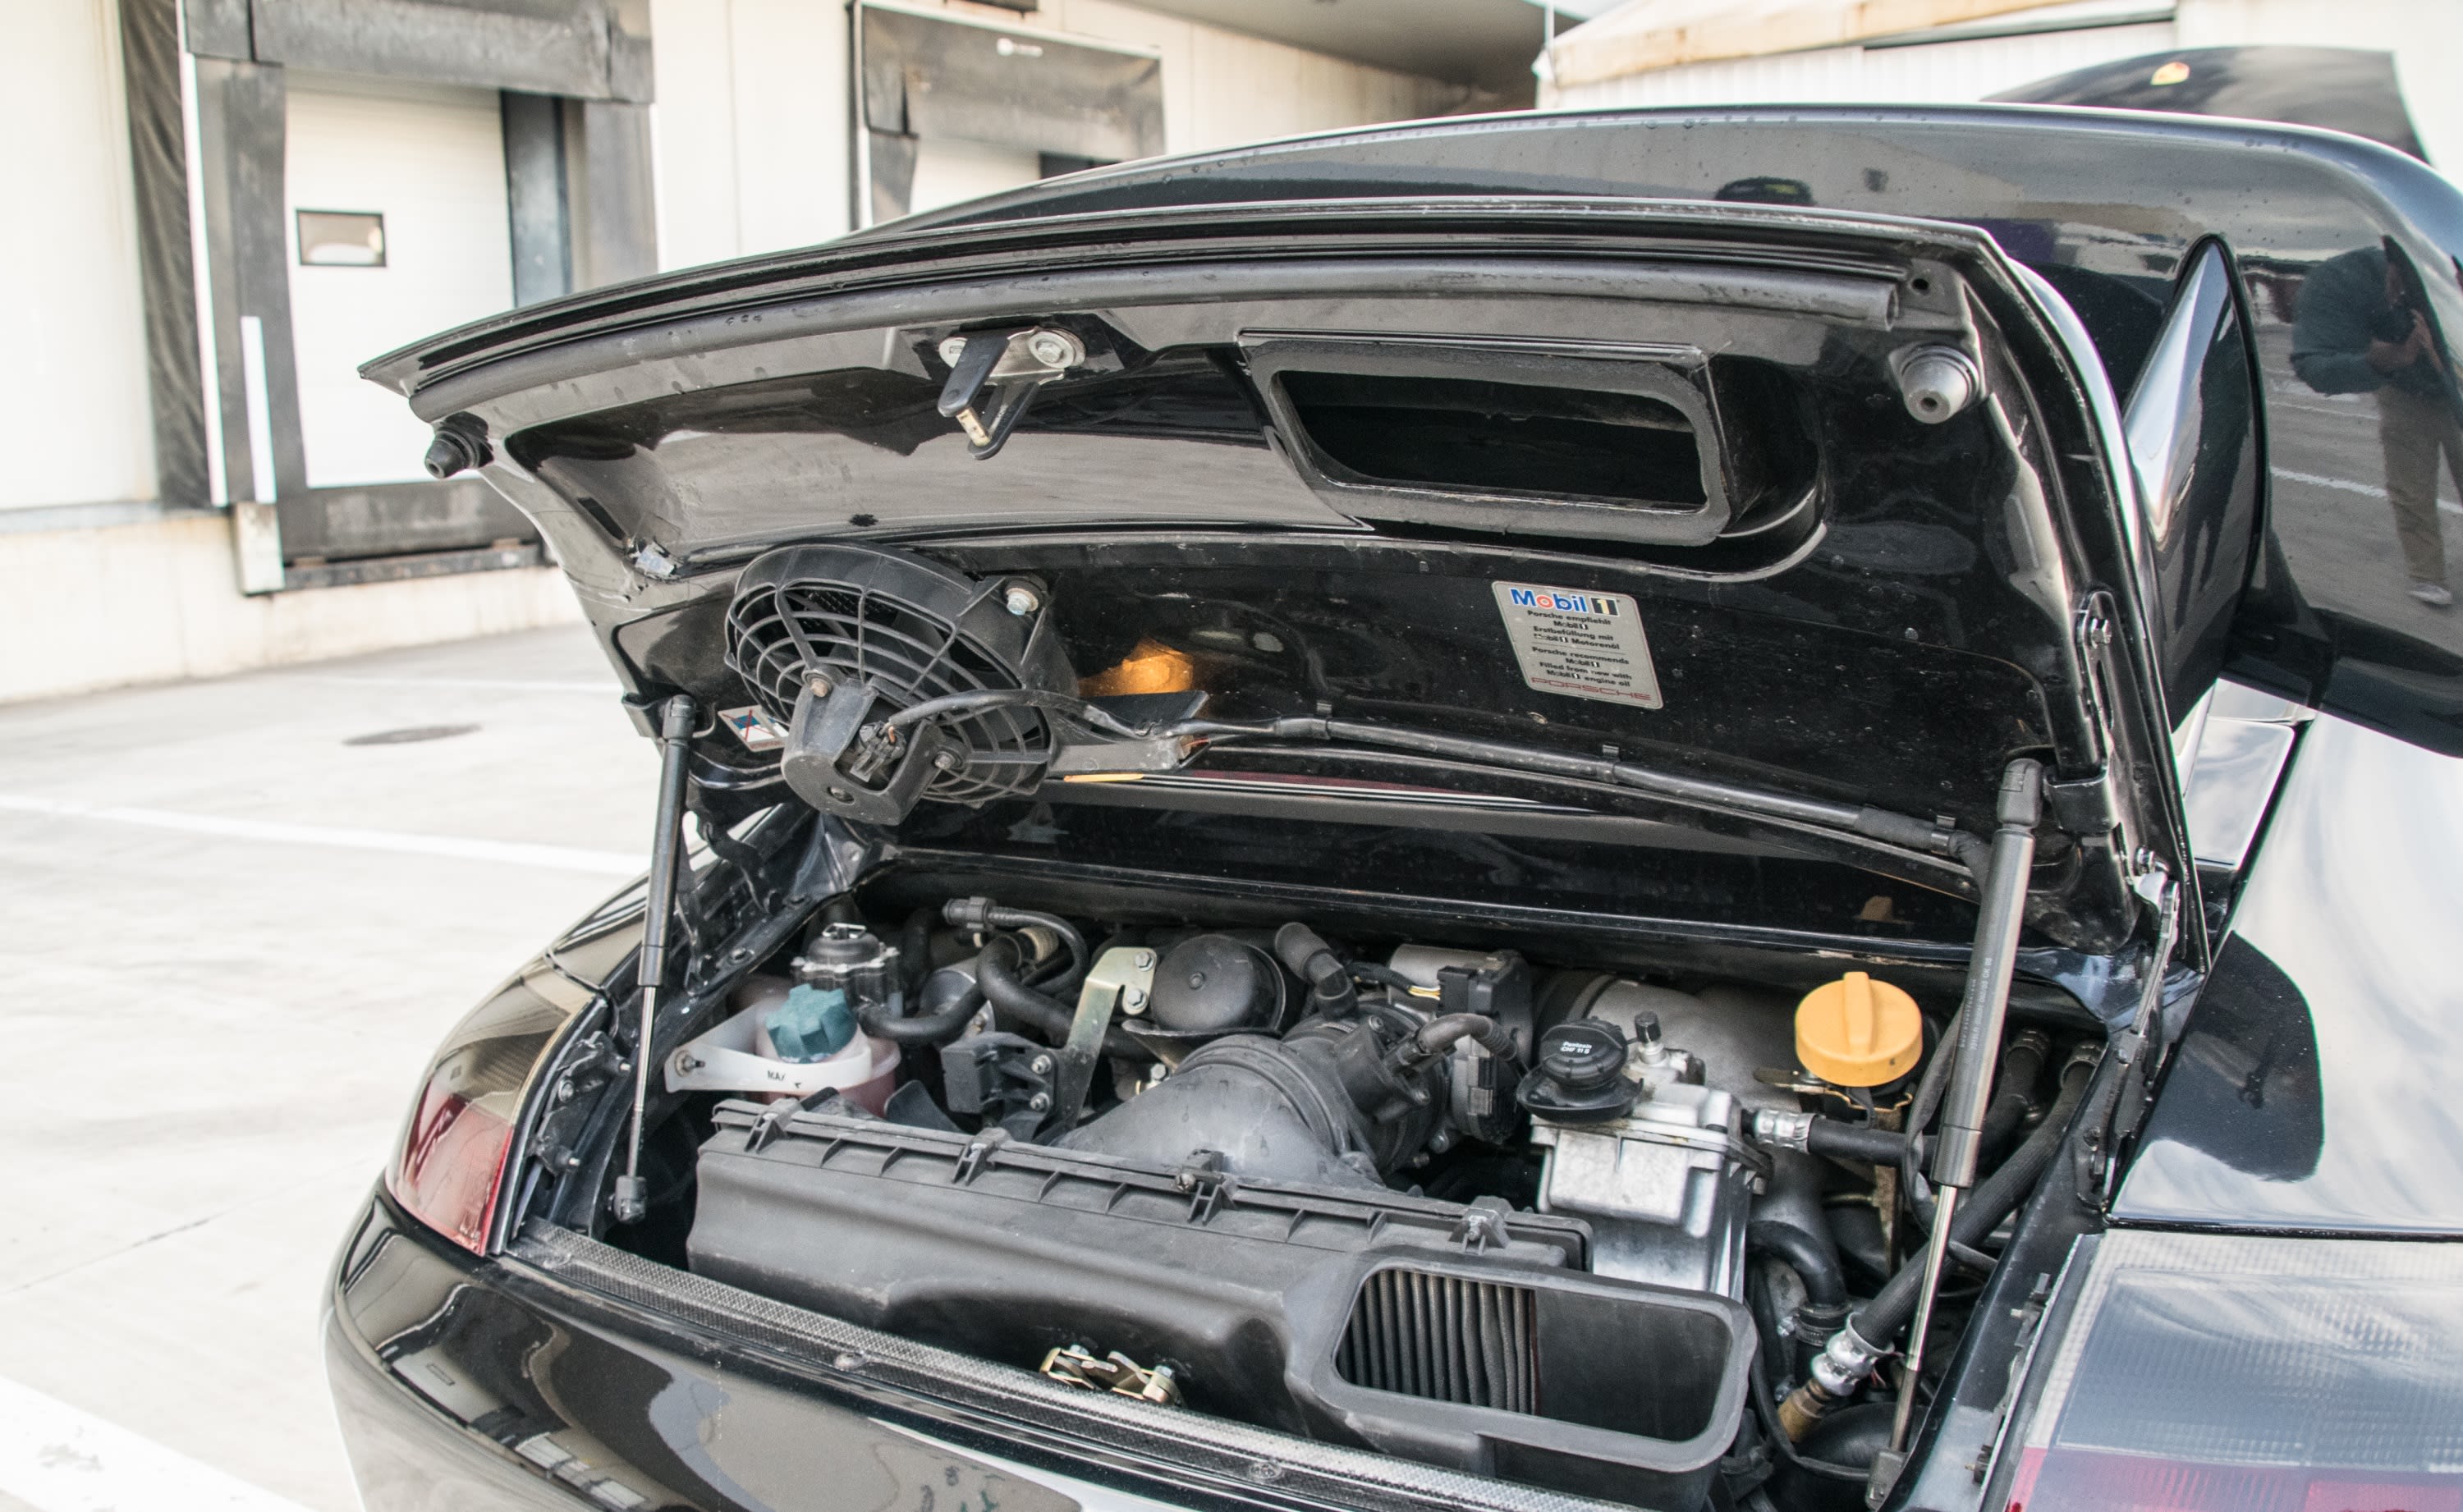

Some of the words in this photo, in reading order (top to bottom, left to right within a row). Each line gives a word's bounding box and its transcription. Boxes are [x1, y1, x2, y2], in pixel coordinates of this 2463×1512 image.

[1510, 588, 1588, 612] Mobil
[1527, 610, 1564, 620] Porsche
[1566, 615, 1611, 625] empfiehlt
[1533, 625, 1596, 639] Erstbefüllung
[1553, 621, 1579, 629] Mobil
[1571, 638, 1620, 649] Motorenöl
[1531, 647, 1567, 657] Porsche
[1570, 653, 1630, 665] recommends
[1565, 657, 1590, 667] Mobil
[1539, 662, 1565, 671] Filled
[1566, 666, 1589, 674] from
[1546, 669, 1571, 678] Mobil
[1584, 676, 1617, 685] engine
[1530, 676, 1653, 701] PORSCHE
